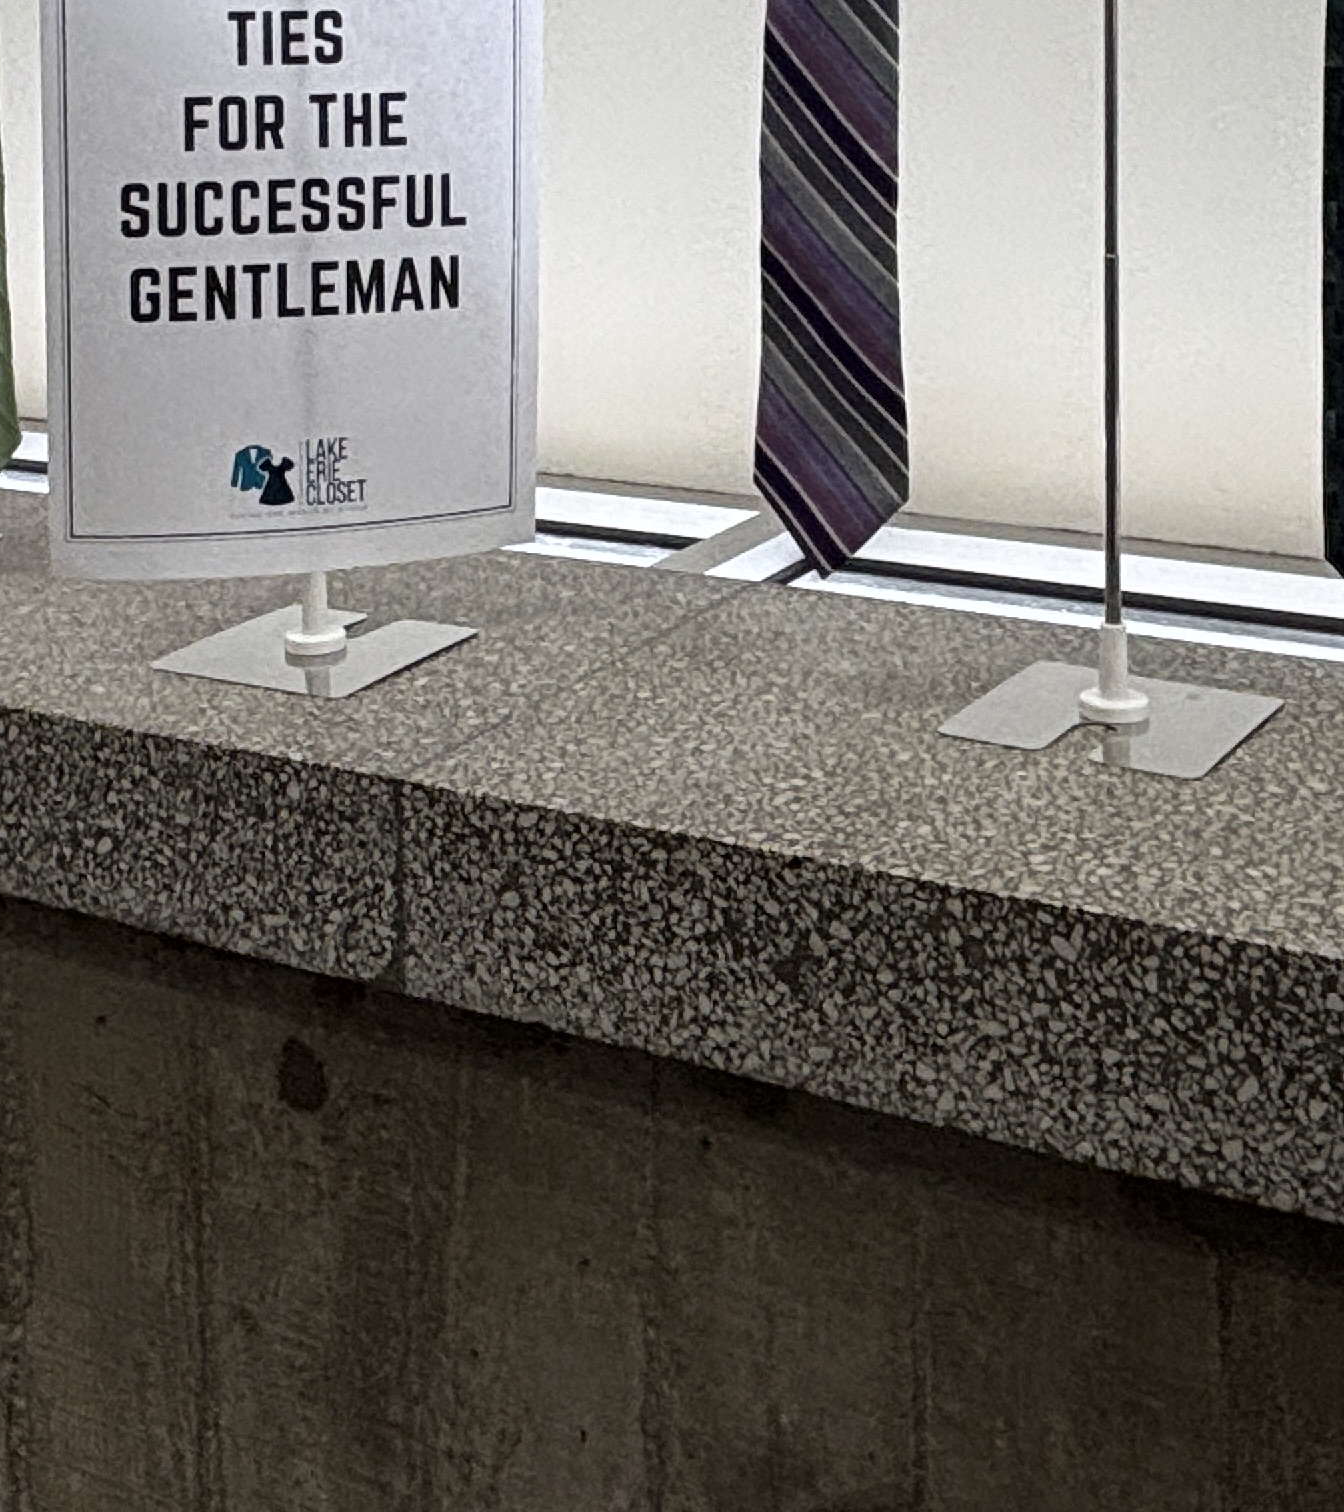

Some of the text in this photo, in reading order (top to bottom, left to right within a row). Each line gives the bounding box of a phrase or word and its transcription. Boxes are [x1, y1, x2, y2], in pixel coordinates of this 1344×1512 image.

[227, 9, 344, 67] TIES
[182, 90, 408, 152] FOR THE
[119, 172, 468, 239] SUCCESSFUL
[129, 254, 461, 324] GENTLEMAN
[305, 436, 349, 461] LAKE
[305, 457, 342, 484] ERIE
[305, 478, 368, 506] CLOSET
